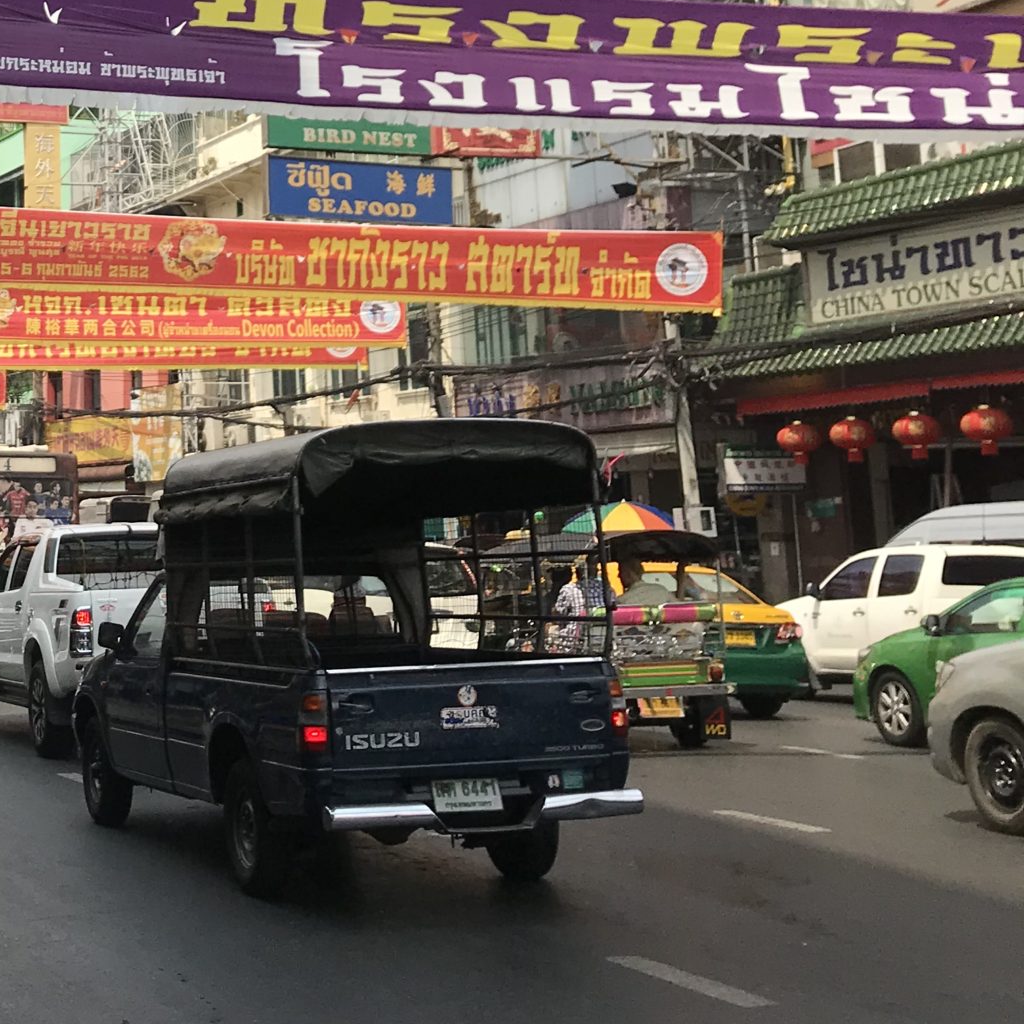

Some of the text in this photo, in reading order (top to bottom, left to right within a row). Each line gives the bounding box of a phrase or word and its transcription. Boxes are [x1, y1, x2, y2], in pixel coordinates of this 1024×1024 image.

[303, 127, 417, 148] BIRD NEST
[307, 197, 417, 219] SEAFOOD
[108, 264, 149, 278] 2562
[821, 293, 886, 319] CHINA
[892, 279, 961, 309] TOWN
[242, 319, 283, 337] Devon
[287, 320, 360, 339] Collection)
[345, 731, 420, 751] ISUZU
